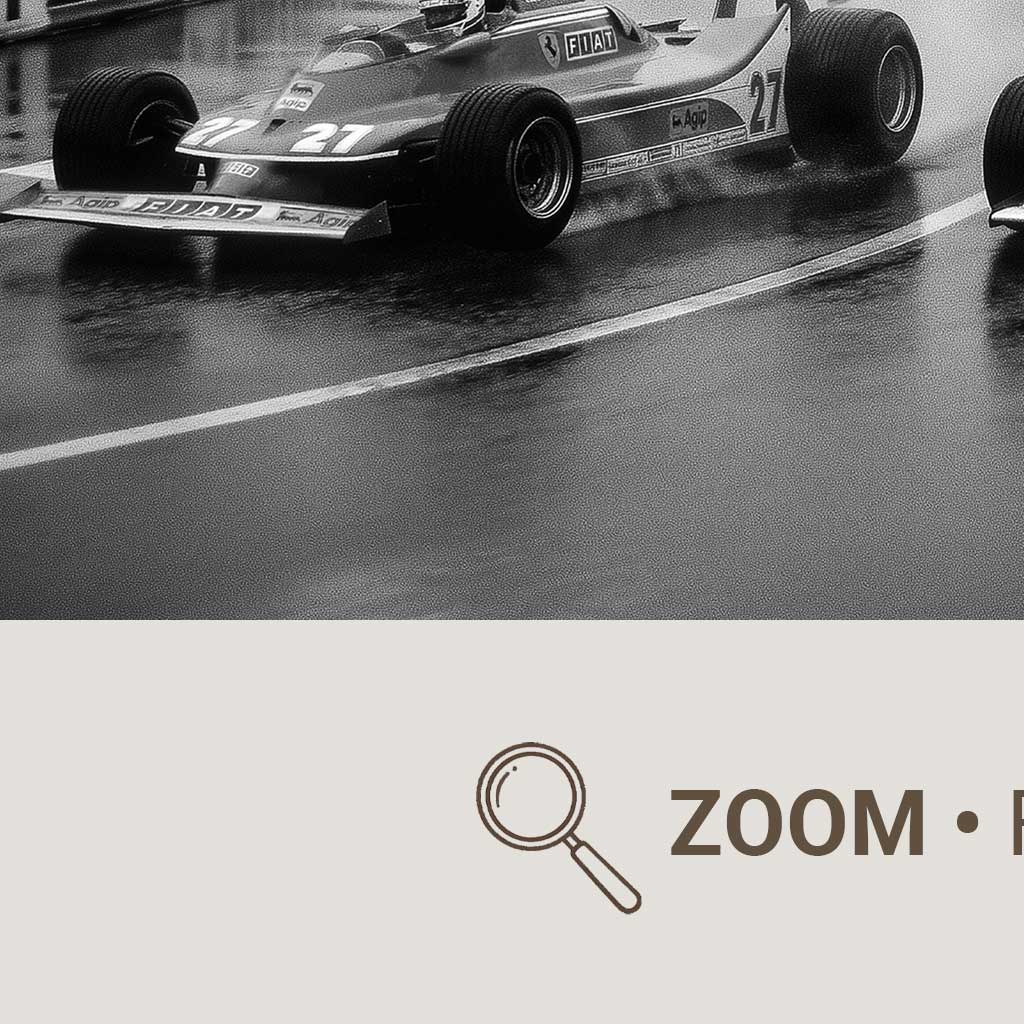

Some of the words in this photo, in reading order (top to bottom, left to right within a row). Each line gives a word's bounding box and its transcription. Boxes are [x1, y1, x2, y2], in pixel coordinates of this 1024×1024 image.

[566, 29, 615, 57] FIAT
[750, 67, 782, 134] 27
[289, 122, 375, 154] 27
[143, 198, 259, 219] FIAT
